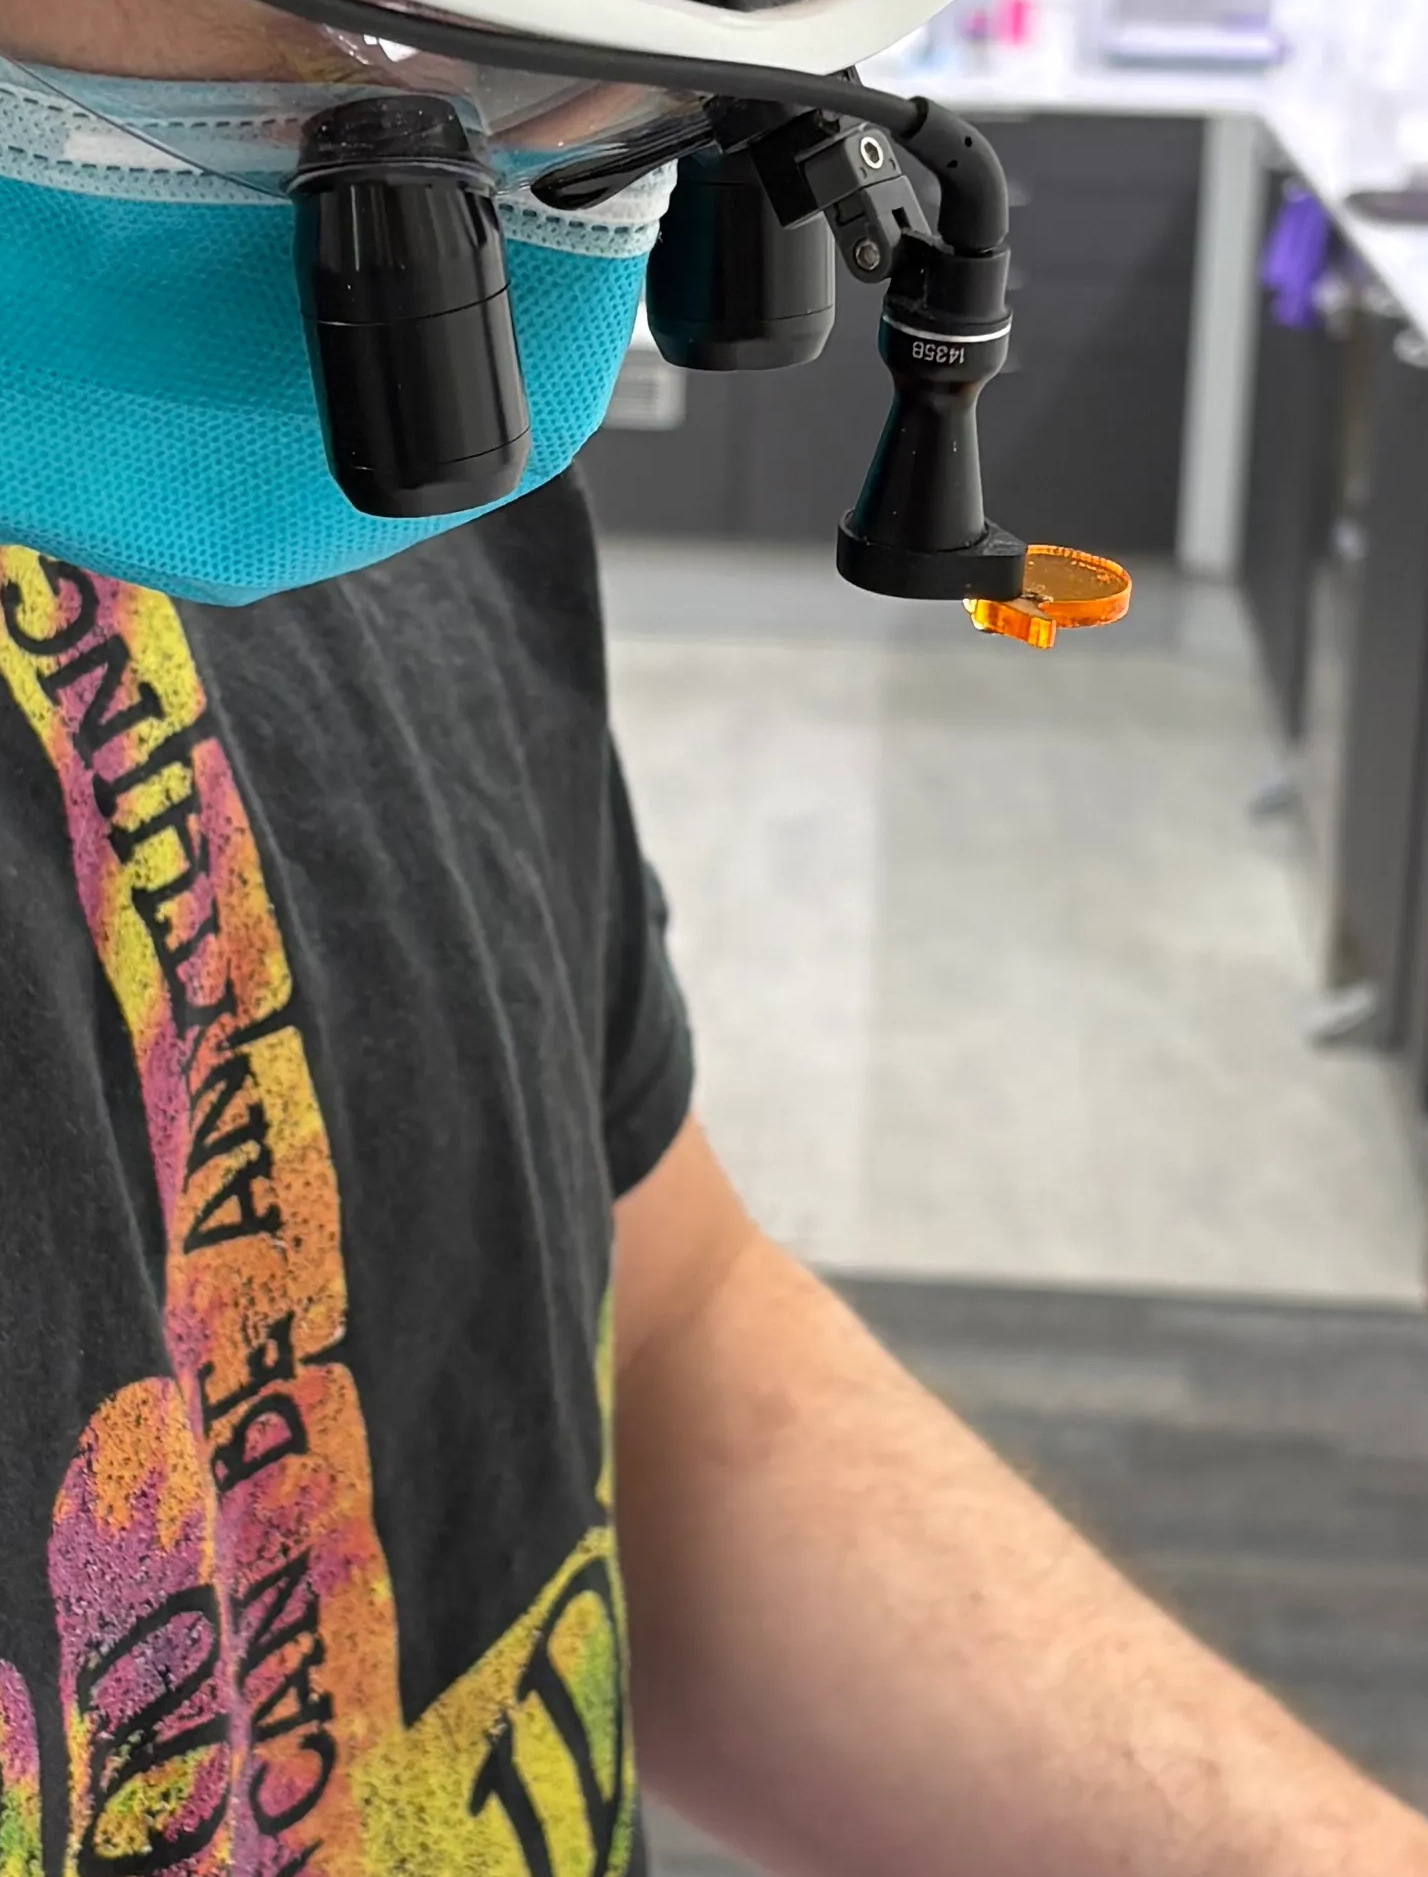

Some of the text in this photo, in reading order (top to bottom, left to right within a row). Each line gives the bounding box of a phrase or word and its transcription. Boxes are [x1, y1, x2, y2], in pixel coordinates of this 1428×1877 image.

[0, 556, 337, 1836] CAN BE ANYTHING
